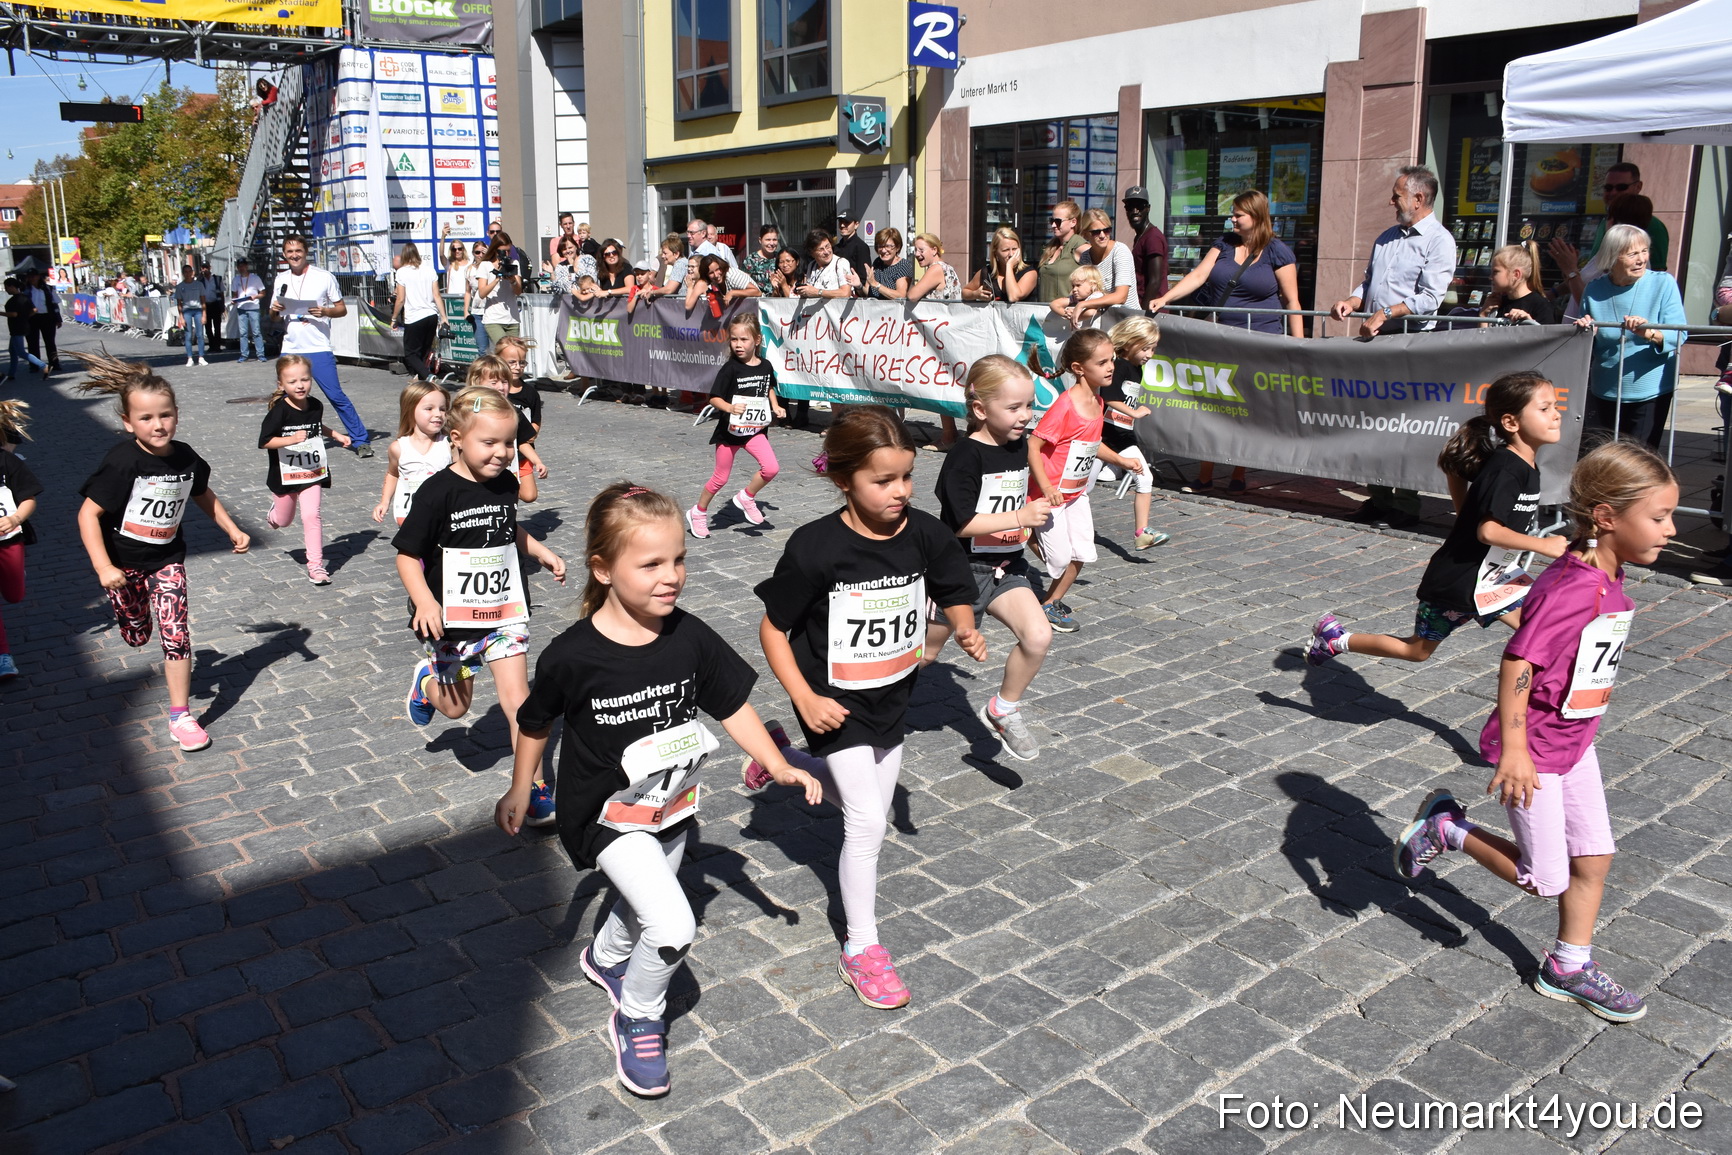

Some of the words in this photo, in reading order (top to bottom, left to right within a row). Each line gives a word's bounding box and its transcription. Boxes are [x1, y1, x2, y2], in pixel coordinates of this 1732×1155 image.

[369, 0, 459, 18] BOCK
[462, 3, 492, 14] OFFIC
[370, 15, 397, 24] inspired
[430, 20, 460, 28] concepts
[960, 86, 986, 98] Unterer
[988, 82, 1007, 94] Markt
[1010, 80, 1018, 91] 15
[860, 112, 876, 134] G2
[1223, 155, 1255, 164] Radfahren
[1550, 203, 1576, 212] Rupprecht
[567, 317, 621, 345] BOCK
[633, 324, 662, 338] OFFICE
[663, 326, 700, 342] INDUSTRY
[816, 316, 859, 344] UNS
[873, 354, 966, 388] BESSER
[1142, 357, 1241, 399] OCK
[1254, 372, 1326, 396] OFFICE
[1331, 378, 1457, 402] INDUSTRY
[1464, 383, 1570, 410] LOE
[1149, 394, 1164, 408] by
[1166, 397, 1198, 410] smart
[1201, 403, 1249, 418] concepts
[1298, 410, 1460, 438] www.bockonlin
[286, 450, 320, 466] 7116
[1001, 478, 1024, 488] BOC
[140, 498, 184, 518] 7037
[450, 504, 501, 520] Neumarkter
[989, 493, 1025, 514] 702
[450, 516, 493, 532] Stadtlauf
[150, 529, 168, 538] Lisa
[1001, 534, 1020, 544] Anna
[470, 555, 504, 566] BOCK
[457, 568, 510, 596] 7032
[834, 574, 909, 592] Neumarkter
[863, 594, 910, 610] BOCK
[472, 608, 502, 619] Emma
[846, 609, 918, 648] 7518
[878, 646, 906, 656] Neumarkt
[1592, 640, 1624, 673] 74
[591, 683, 676, 710] Neumarkter
[594, 701, 660, 725] Stadtlauf
[656, 733, 700, 758] BOCK
[634, 792, 660, 802] PARTL
